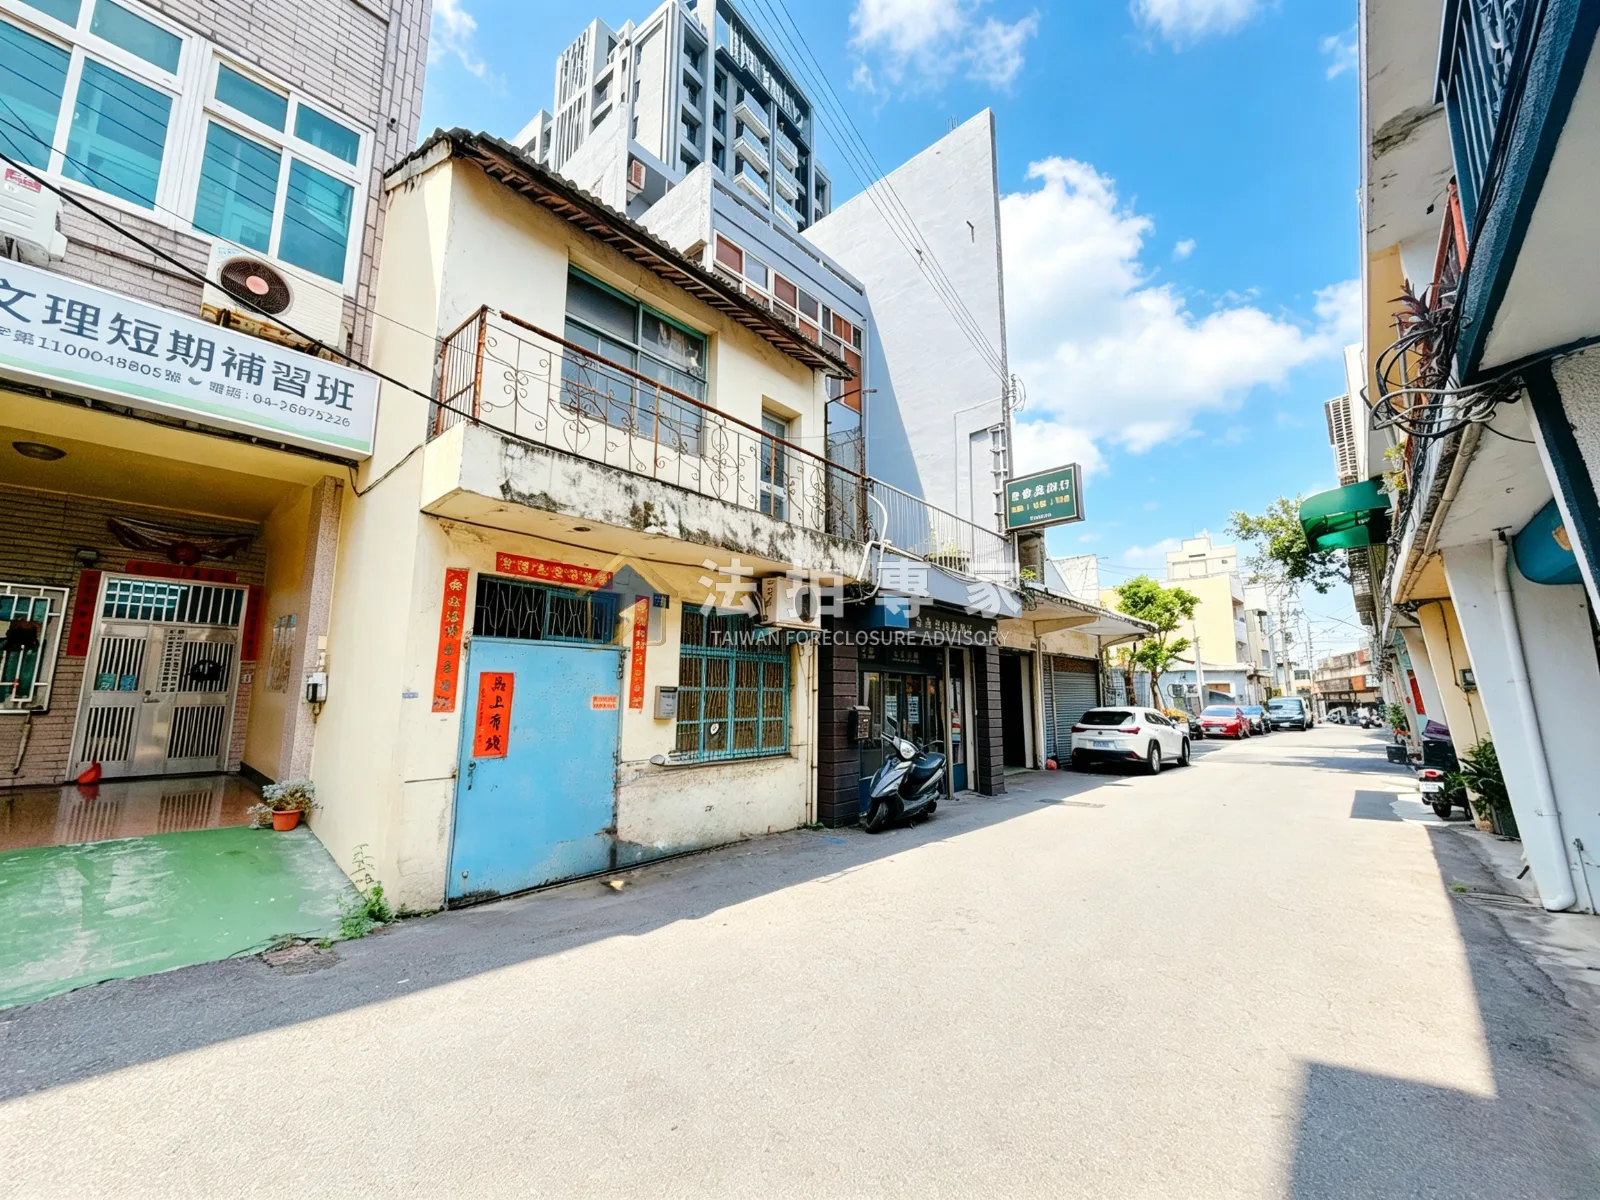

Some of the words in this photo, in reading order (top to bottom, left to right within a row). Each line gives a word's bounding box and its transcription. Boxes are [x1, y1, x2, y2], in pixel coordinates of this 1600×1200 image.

[0, 278, 355, 411] 文理短期補習班
